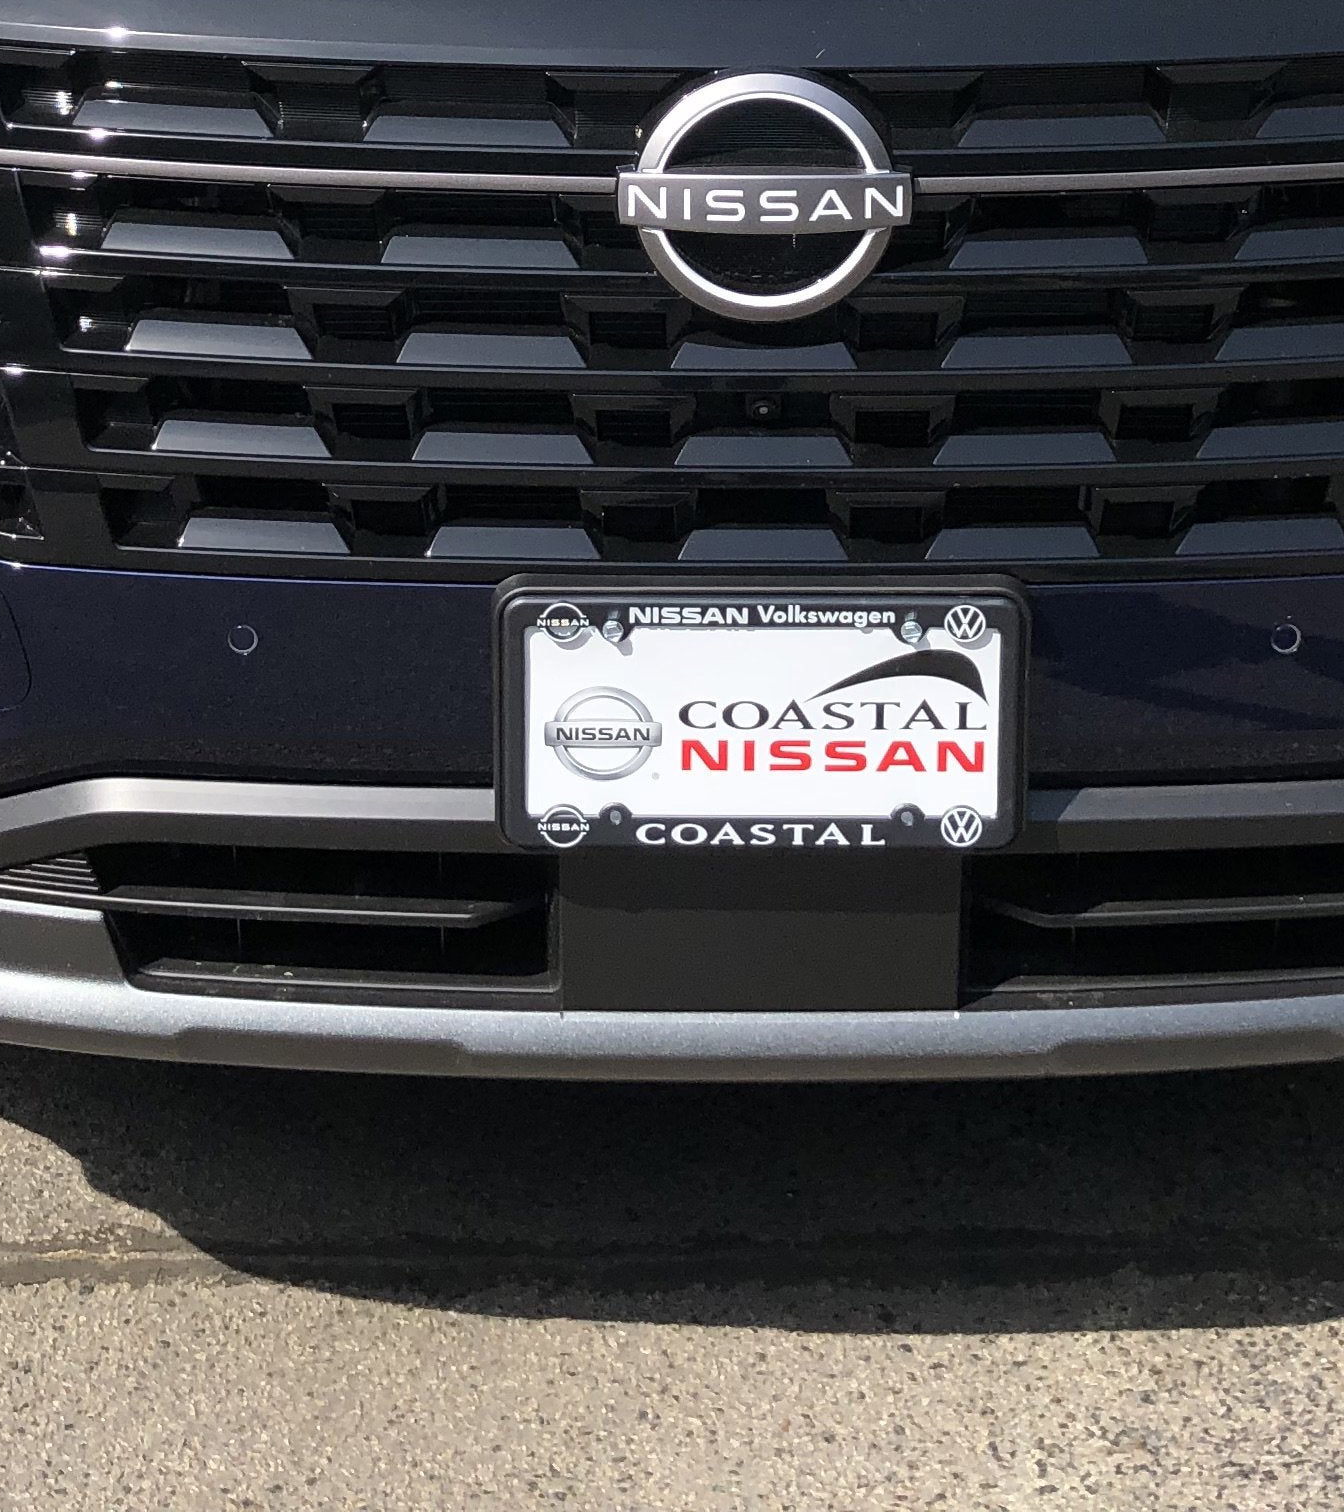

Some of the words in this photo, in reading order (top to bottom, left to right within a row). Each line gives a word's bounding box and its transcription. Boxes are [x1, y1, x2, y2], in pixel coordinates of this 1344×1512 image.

[627, 184, 904, 222] NISSAN
[536, 618, 590, 627] NISSAN
[629, 606, 749, 625] NISSAN
[756, 604, 896, 628] Volkswagen
[678, 698, 988, 730] COASTAL
[556, 727, 650, 741] NISSAN
[681, 739, 985, 772] NISSAN
[537, 822, 590, 831] NISSAN
[635, 822, 886, 846] COASTAL
